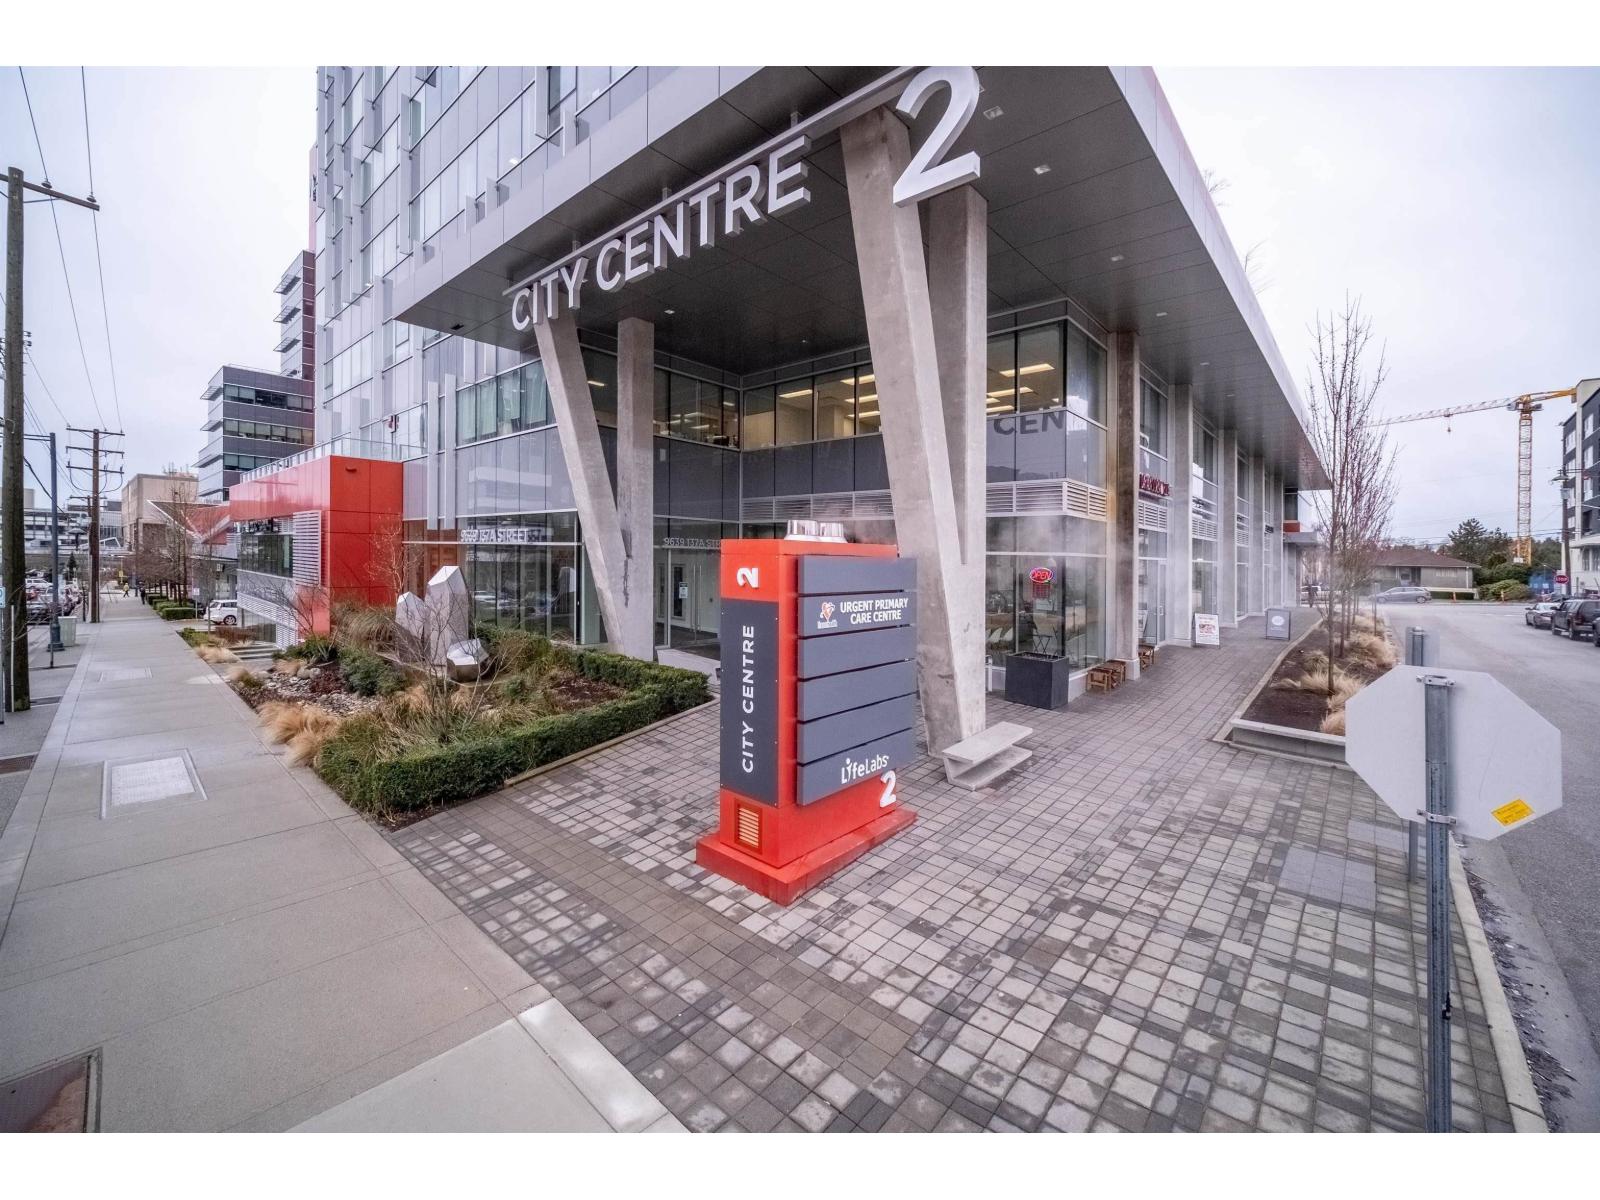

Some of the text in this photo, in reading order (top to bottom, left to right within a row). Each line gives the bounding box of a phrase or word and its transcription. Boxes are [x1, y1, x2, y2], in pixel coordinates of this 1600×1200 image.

[511, 66, 981, 332] CITY CENTRE 2
[497, 527, 529, 542] STREET
[663, 537, 685, 547] 9639
[687, 538, 705, 549] 137A
[736, 567, 759, 588] 2
[1031, 571, 1051, 581] OPEN
[840, 597, 909, 613] URGENT PRIMARY
[850, 612, 872, 625] CARE
[873, 609, 902, 622] CENTRE
[742, 625, 755, 773] CITY CENTRE
[841, 754, 889, 784] LifeLabs
[879, 770, 897, 808] 2
